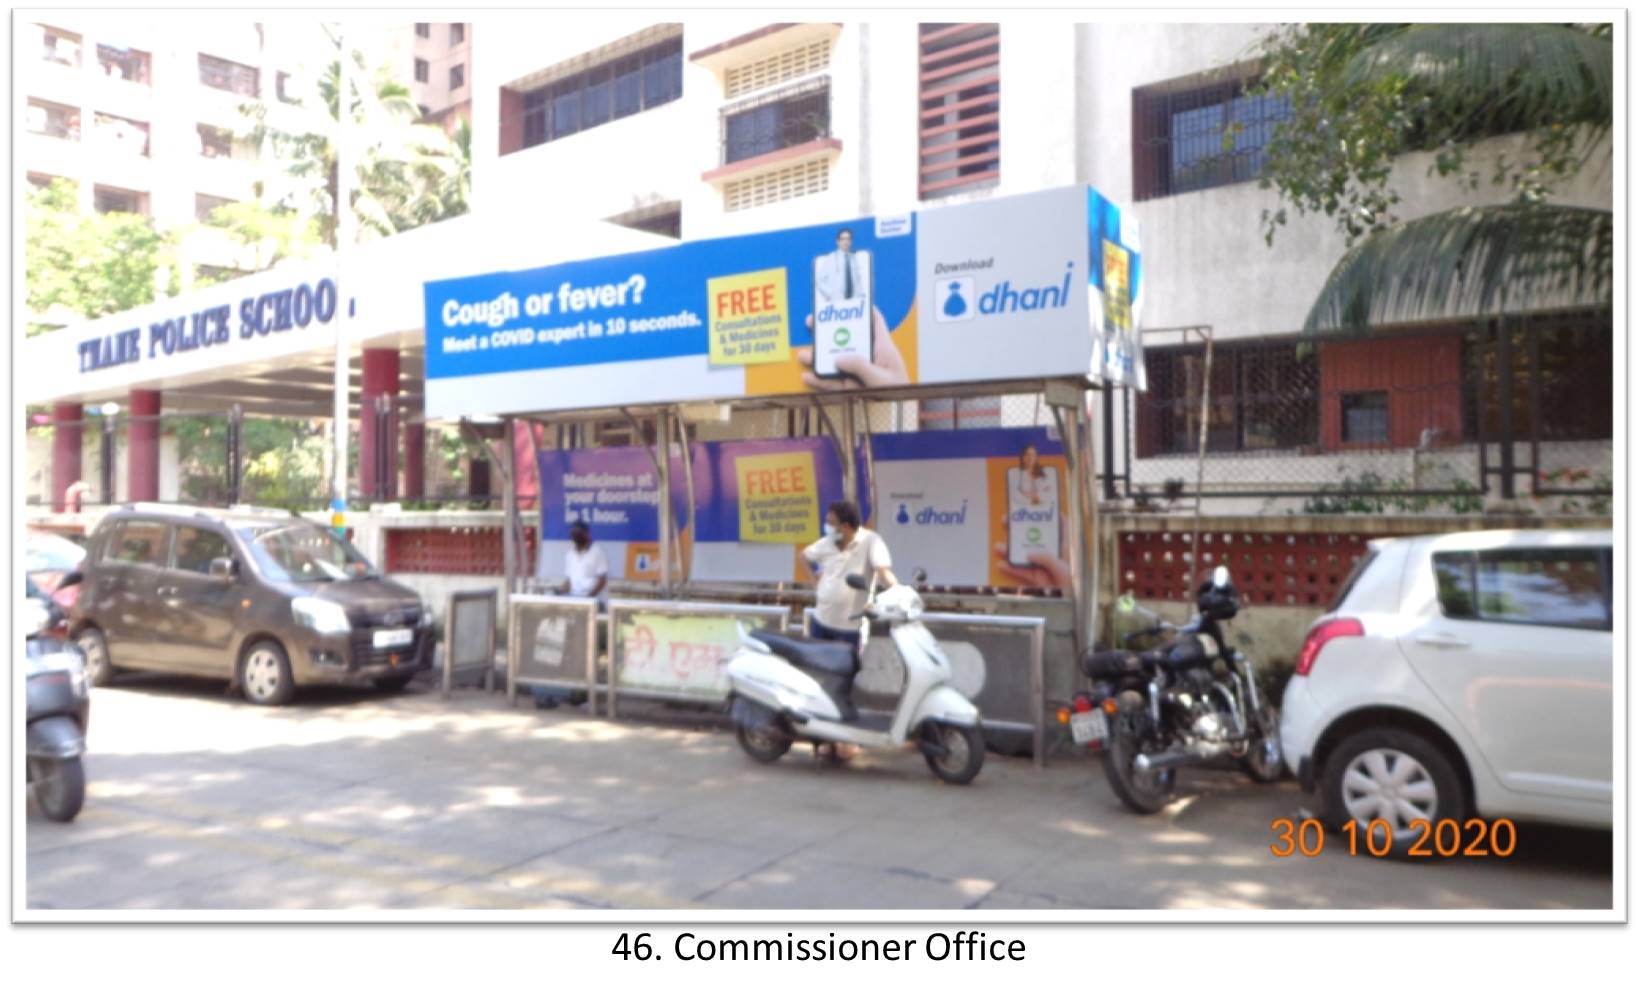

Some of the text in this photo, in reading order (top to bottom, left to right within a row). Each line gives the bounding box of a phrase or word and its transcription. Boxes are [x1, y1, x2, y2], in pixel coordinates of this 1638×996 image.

[934, 256, 995, 275] Download
[442, 274, 647, 327] Cough or fever?
[716, 283, 777, 319] FREE
[978, 261, 1074, 315] dhani
[817, 294, 866, 323] dhani
[77, 277, 356, 373] THANE POLICE SCHOO
[442, 309, 702, 353] Meet a COVID expert in 10 seconds.
[715, 314, 782, 332] Consultations
[729, 327, 779, 342] Medicines
[723, 340, 776, 356] for 30 days
[562, 471, 653, 489] Medicines at
[746, 465, 807, 496] FREE
[564, 491, 595, 511] your
[915, 499, 969, 525] dhani
[1012, 502, 1054, 522] dhani
